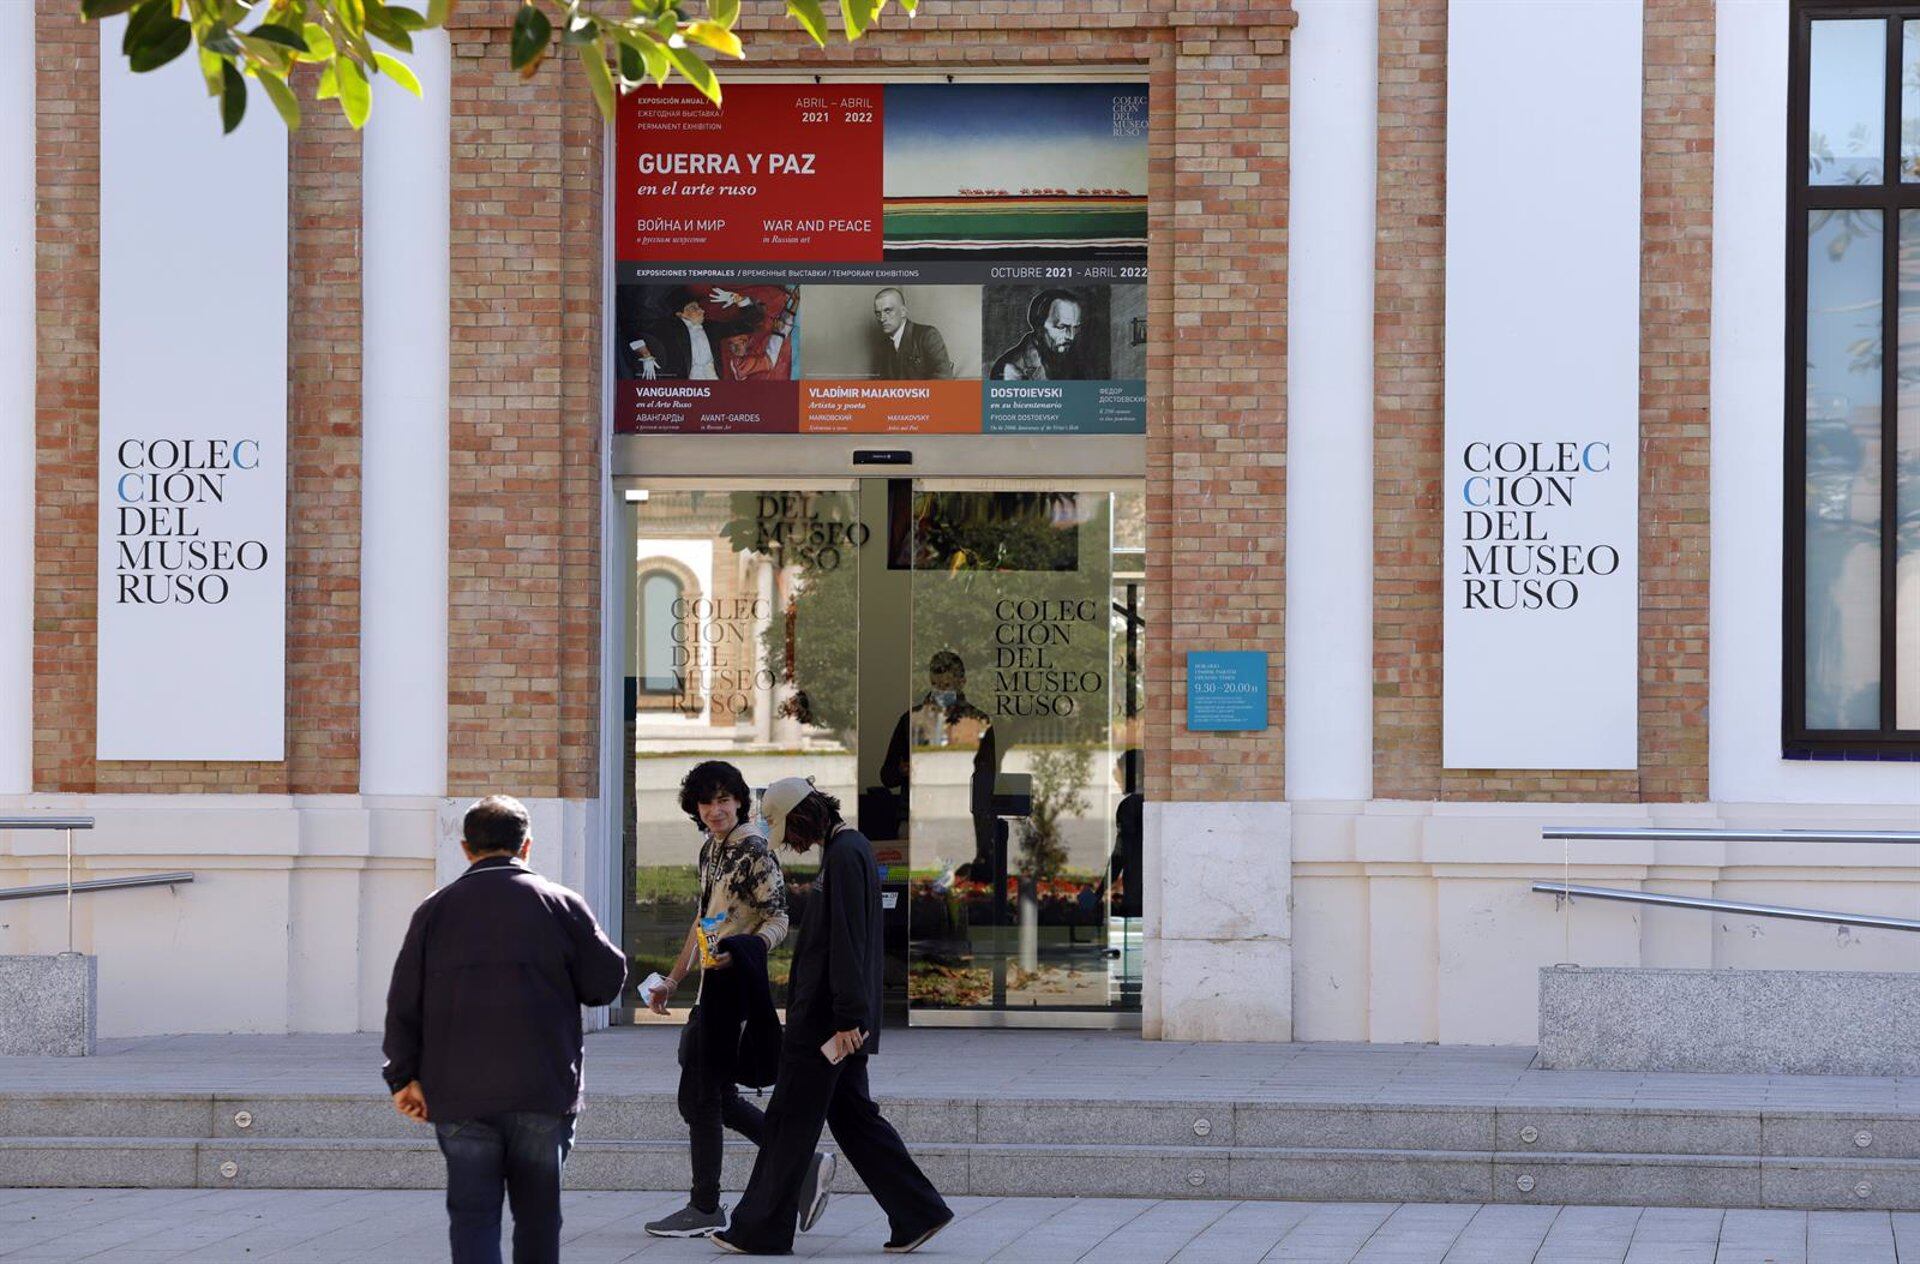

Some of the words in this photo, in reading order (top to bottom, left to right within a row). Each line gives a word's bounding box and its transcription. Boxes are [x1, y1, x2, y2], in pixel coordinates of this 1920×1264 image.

[637, 96, 679, 104] EXPOSICIÓN
[795, 98, 828, 108] ABRIL
[840, 98, 873, 108] ABRIL
[802, 112, 829, 123] 2021
[844, 112, 873, 123] 2022
[638, 153, 741, 175] GUERRA
[746, 153, 762, 174] Y
[768, 153, 816, 174] PAZ
[637, 185, 657, 196] en
[661, 181, 677, 196] el
[681, 183, 714, 196] arte
[719, 185, 757, 196] ruso
[637, 217, 682, 232] ВОЙНА
[684, 220, 695, 232] И
[697, 220, 726, 232] МИР
[763, 220, 793, 232] WAR
[796, 220, 824, 232] AND
[828, 220, 872, 232] PEACE
[636, 269, 687, 277] EXPOSICIONES
[688, 269, 735, 277] TEMPORALES
[742, 269, 787, 277] ВРЕМЕННЫЕ
[788, 269, 827, 277] ВЫСТАВКИ
[832, 269, 874, 277] TEMPORARY
[875, 269, 920, 277] EXHIBITIONS
[990, 267, 1043, 278] OCTUBRE
[1045, 267, 1073, 278] 2021
[1084, 267, 1117, 278] ABRIL
[1120, 267, 1148, 278] 2022
[636, 387, 711, 397] VANGUARDIAS
[809, 386, 859, 398] VLADÍMIR
[861, 388, 930, 398] MAIAKOVSKI
[990, 388, 1063, 398] DOSTOIEVSKI
[808, 401, 836, 409] Artista
[843, 402, 866, 410] poeta
[1012, 400, 1063, 409] bicentenario
[636, 413, 685, 422] АВАНГАРДЫ
[700, 413, 761, 422] AVANT-GARDES
[118, 439, 259, 469] COLEC
[1463, 441, 1610, 473] COLEC
[117, 469, 226, 502] CIÓN
[1463, 472, 1576, 506] CIÓN
[756, 495, 818, 519] DEL
[117, 507, 200, 536] DEL
[1462, 510, 1548, 541] DEL
[756, 522, 870, 546] MUSEO
[116, 540, 268, 570] MUSEO
[1462, 544, 1619, 575] MUSEO
[116, 574, 229, 604] RUSO
[1462, 579, 1579, 610] RUSO
[670, 598, 770, 620] COLEC
[995, 599, 1096, 622] COLEC
[995, 621, 1072, 645] CIÓN
[671, 645, 728, 667] DEL
[996, 647, 1053, 669] DEL
[671, 669, 776, 691] MUSEO
[994, 671, 1102, 693] MUSEO
[671, 693, 749, 714] RUSO
[996, 694, 1074, 717] RUSO
